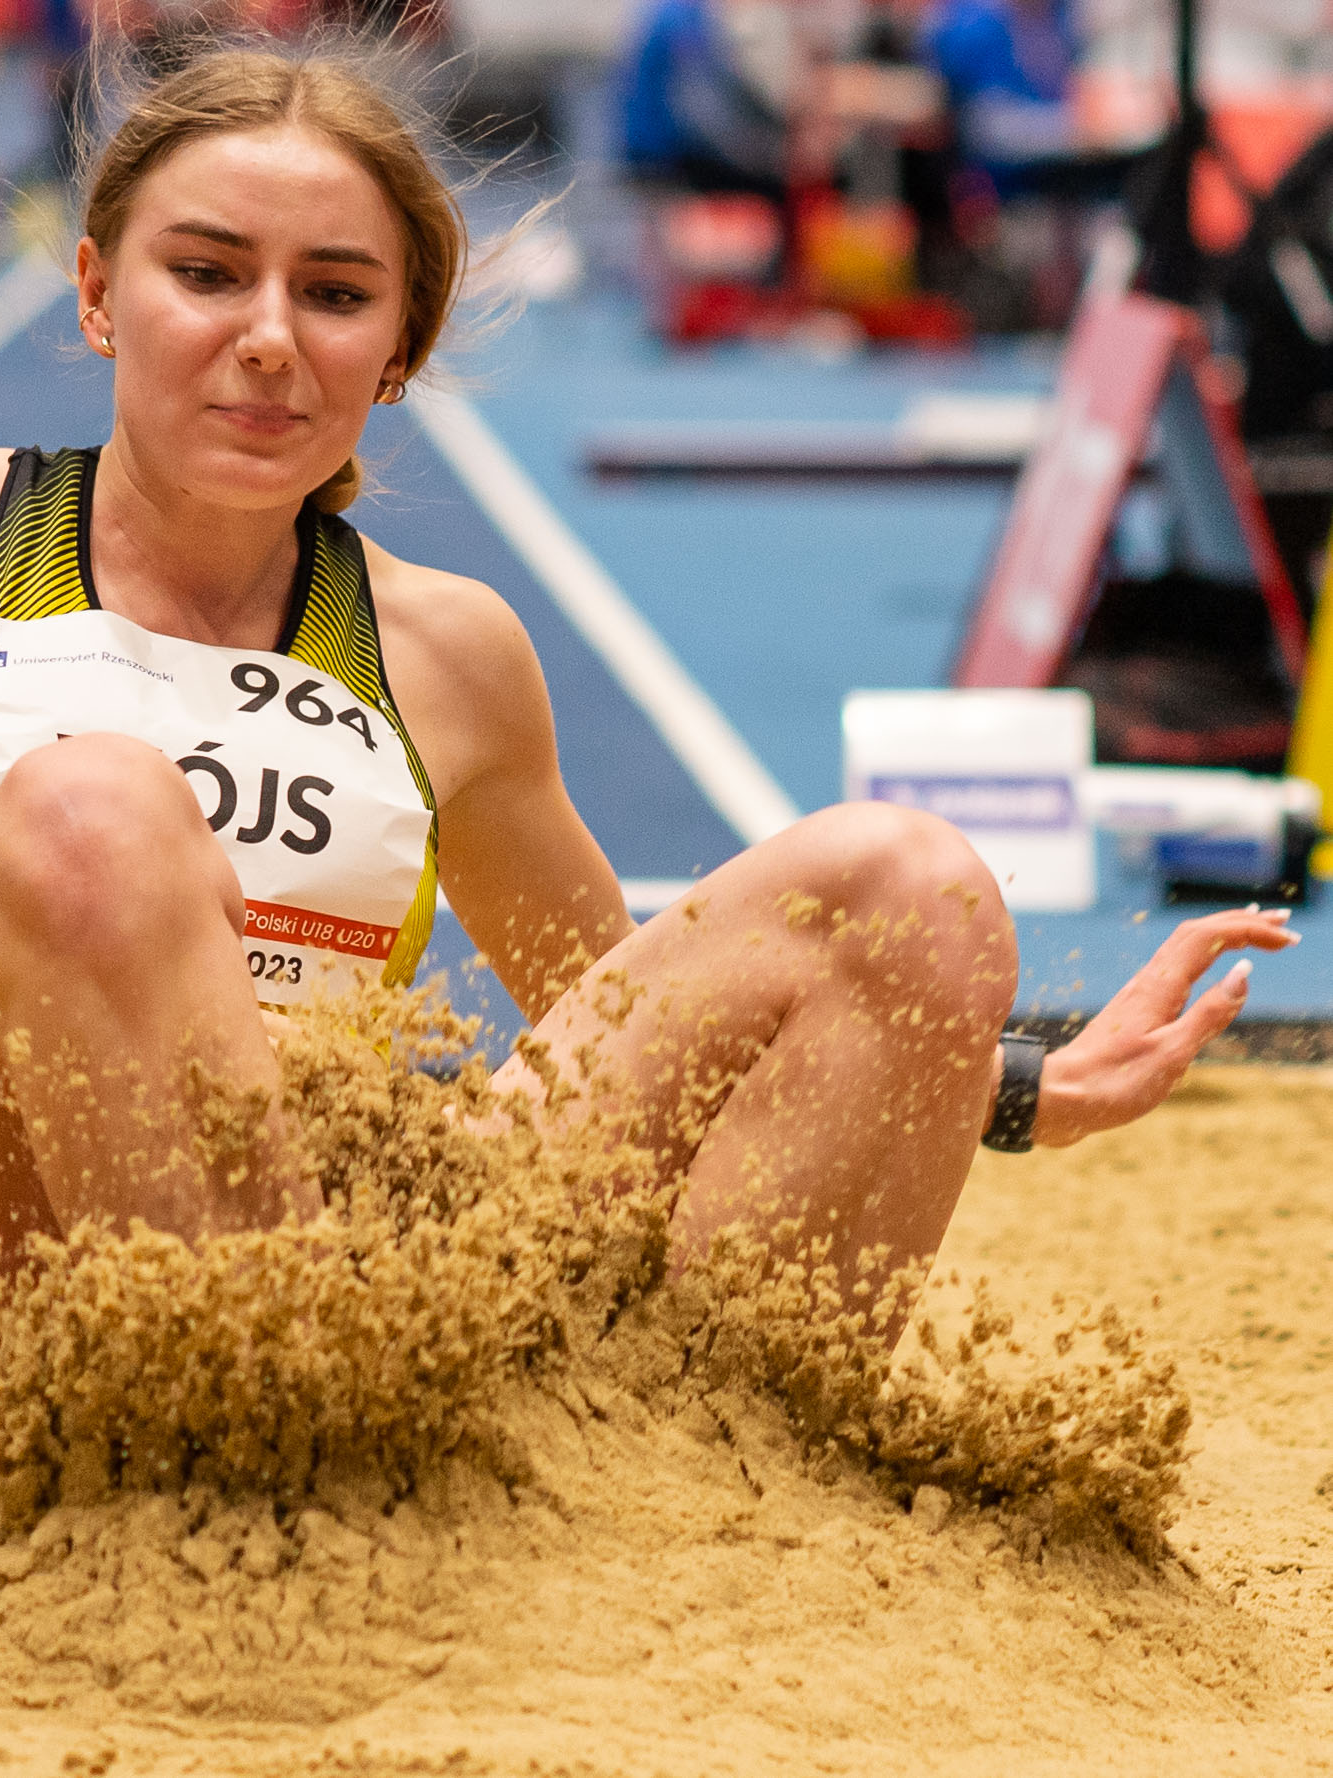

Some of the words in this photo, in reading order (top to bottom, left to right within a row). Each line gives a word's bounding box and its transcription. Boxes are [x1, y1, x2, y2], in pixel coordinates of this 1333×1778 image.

[14, 652, 96, 666] Uniwersytet
[101, 651, 175, 683] Rzeszowski
[230, 662, 378, 753] 964
[57, 733, 335, 855] ÓJS
[244, 909, 299, 934] Polski
[300, 919, 335, 941] U18
[336, 928, 376, 949] U20
[246, 950, 303, 985] 023
